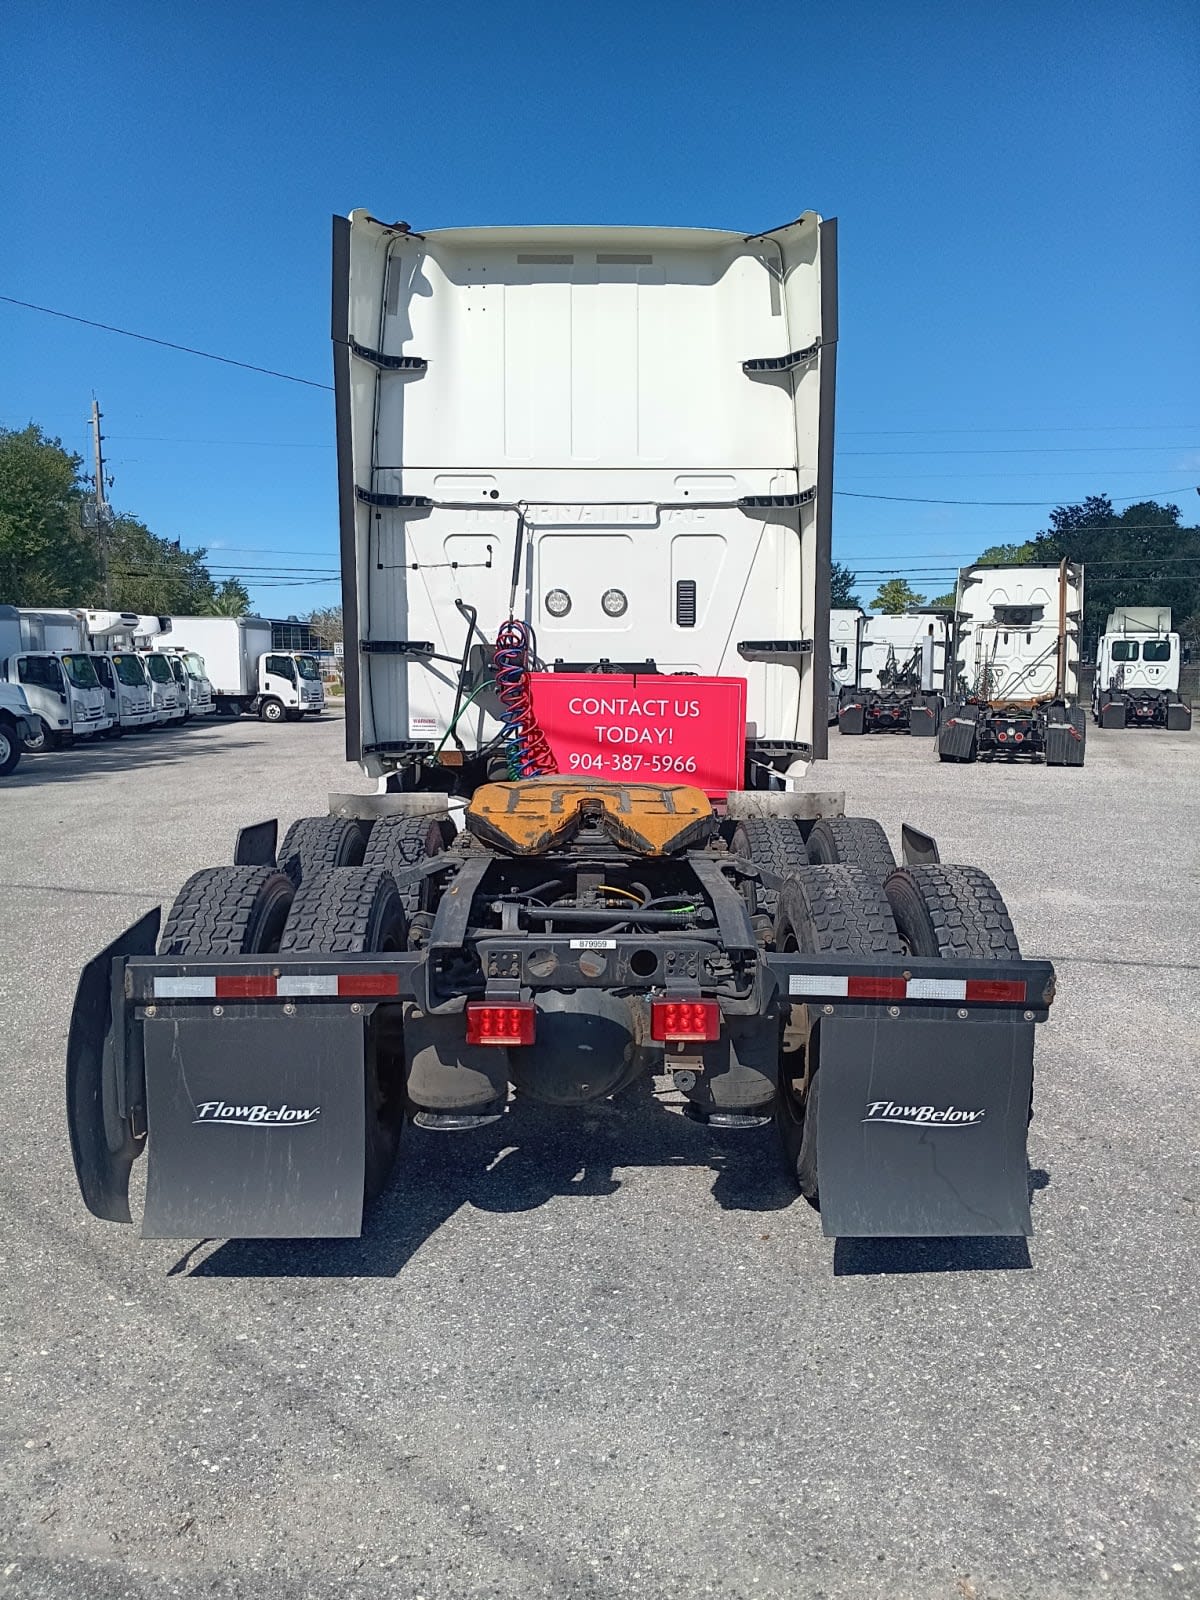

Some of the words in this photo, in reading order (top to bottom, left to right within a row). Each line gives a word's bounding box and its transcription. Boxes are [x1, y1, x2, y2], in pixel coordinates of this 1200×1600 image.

[568, 697, 670, 716] CONTACT
[674, 700, 701, 717] US
[594, 726, 674, 745] TODAY!
[568, 753, 697, 773] 904-387-5966
[196, 1101, 321, 1122] FlowBelow
[865, 1101, 986, 1122] FlowBelow
